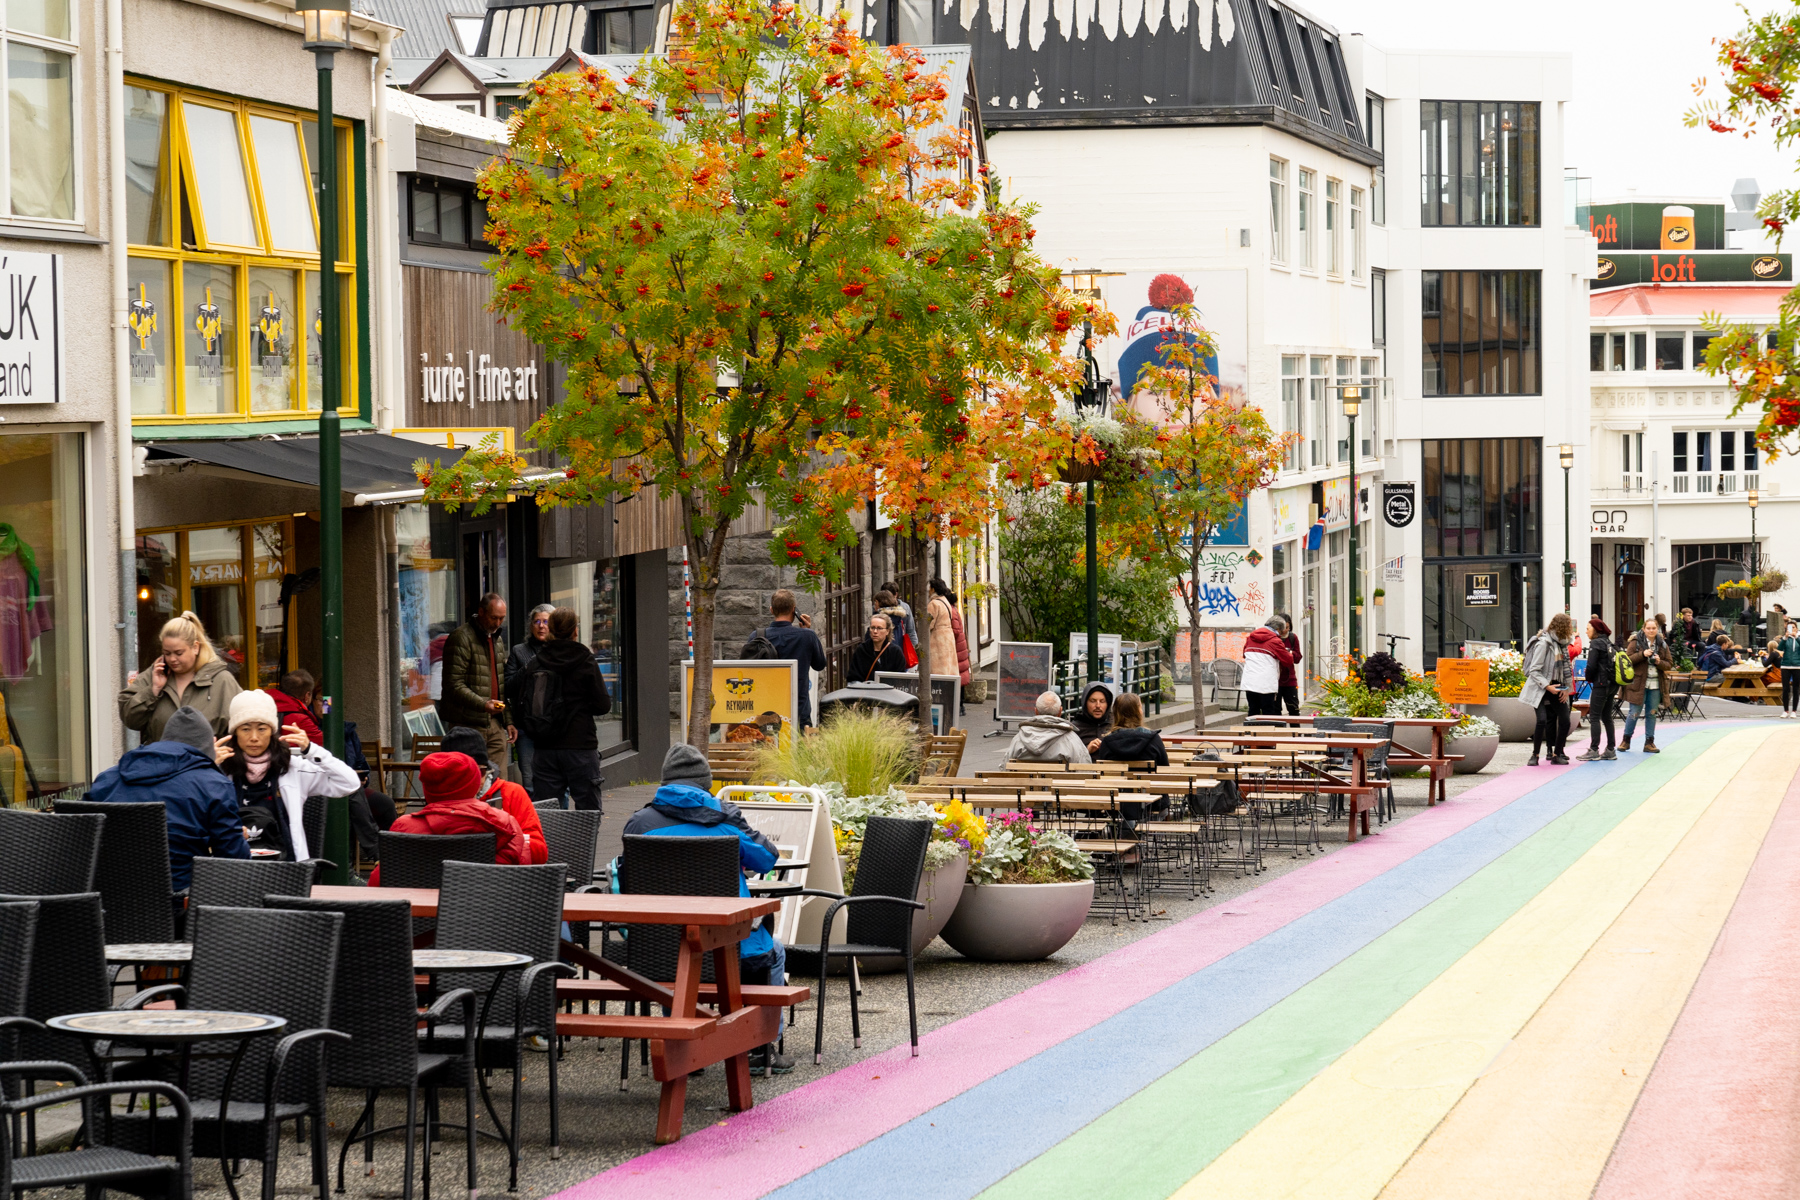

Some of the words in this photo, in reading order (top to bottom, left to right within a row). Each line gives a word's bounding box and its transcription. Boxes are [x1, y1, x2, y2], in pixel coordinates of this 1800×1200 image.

[1589, 214, 1618, 244] loft
[1651, 255, 1697, 282] loft
[421, 352, 466, 403] iurie
[477, 353, 512, 402] fine
[514, 359, 539, 401] art
[726, 698, 754, 712] REYKJAVÍK
